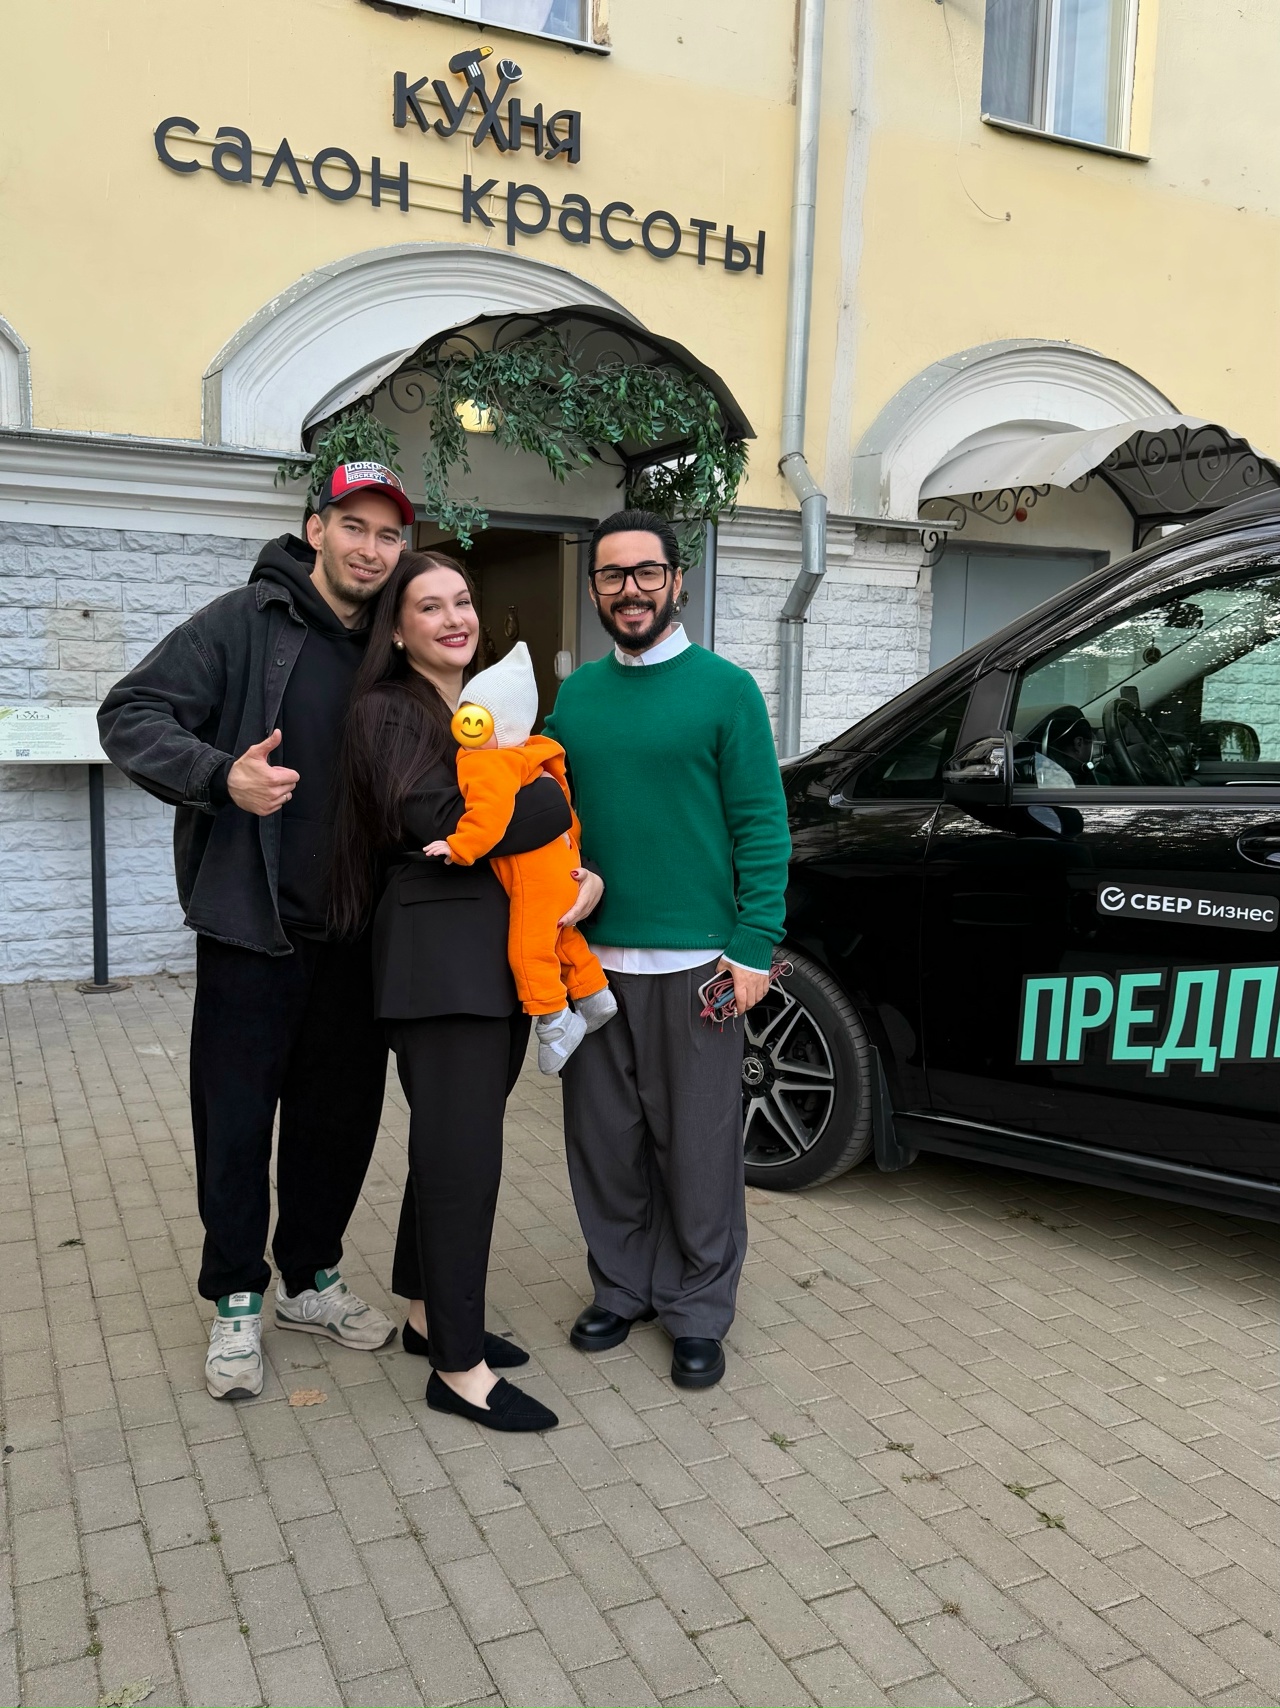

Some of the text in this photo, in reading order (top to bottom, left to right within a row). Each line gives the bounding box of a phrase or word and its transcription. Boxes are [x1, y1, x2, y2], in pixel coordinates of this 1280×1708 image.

[461, 174, 766, 275] красоты
[1130, 893, 1274, 923] СБЕР Бизнес
[1020, 966, 1280, 1073] ПРЕДП
